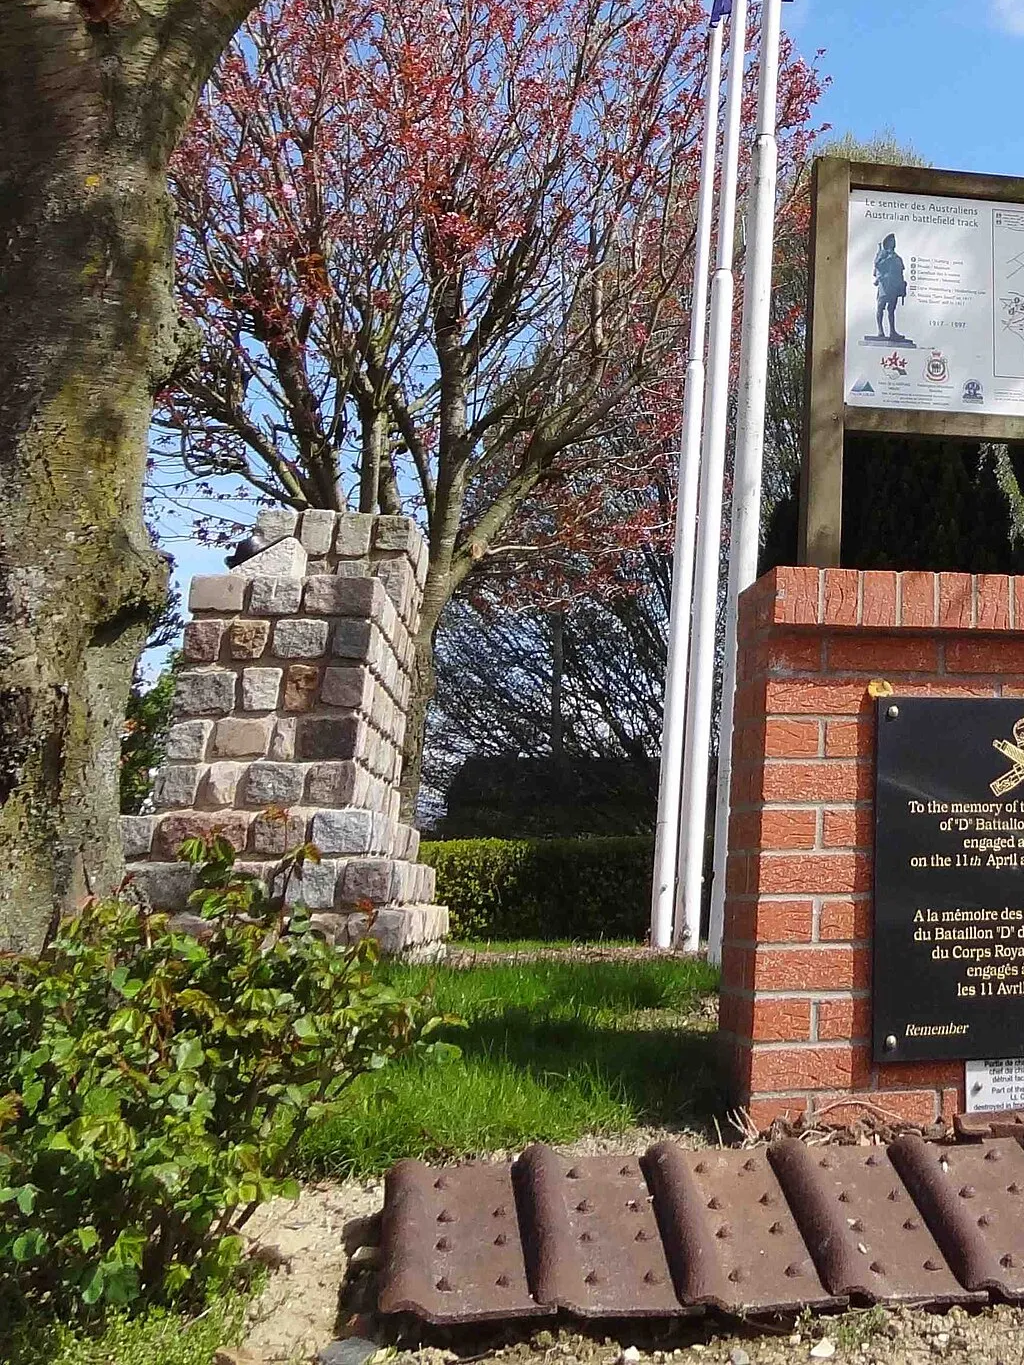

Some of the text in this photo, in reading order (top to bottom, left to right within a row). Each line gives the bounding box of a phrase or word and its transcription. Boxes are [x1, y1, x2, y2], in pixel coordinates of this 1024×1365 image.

[865, 198, 978, 216] Le sentier des Australiens
[864, 210, 979, 228] Australian battlefield track
[908, 800, 924, 814] To
[927, 800, 948, 814] the
[951, 802, 1002, 816] memory
[1006, 800, 1018, 813] of
[940, 818, 954, 831] of
[954, 818, 973, 830] "D"
[964, 835, 1015, 852] engaged
[910, 856, 927, 867] on
[930, 854, 952, 867] the
[986, 854, 1018, 870] April
[914, 909, 924, 922] A
[926, 908, 939, 922] la
[942, 908, 998, 922] mémoire
[1000, 906, 1023, 920] des
[914, 928, 932, 941] du
[934, 926, 994, 940] Bataillon
[996, 926, 1015, 939] "D"
[932, 946, 950, 959] du
[952, 945, 992, 962] Corps
[966, 963, 1018, 980] engagés
[957, 982, 976, 996] les
[981, 982, 993, 996] 11
[904, 1022, 970, 1036] Remember
[992, 1086, 1005, 1094] Part
[1006, 1085, 1014, 1094] of
[1014, 1084, 1024, 1093] the
[1006, 1102, 1012, 1110] in
